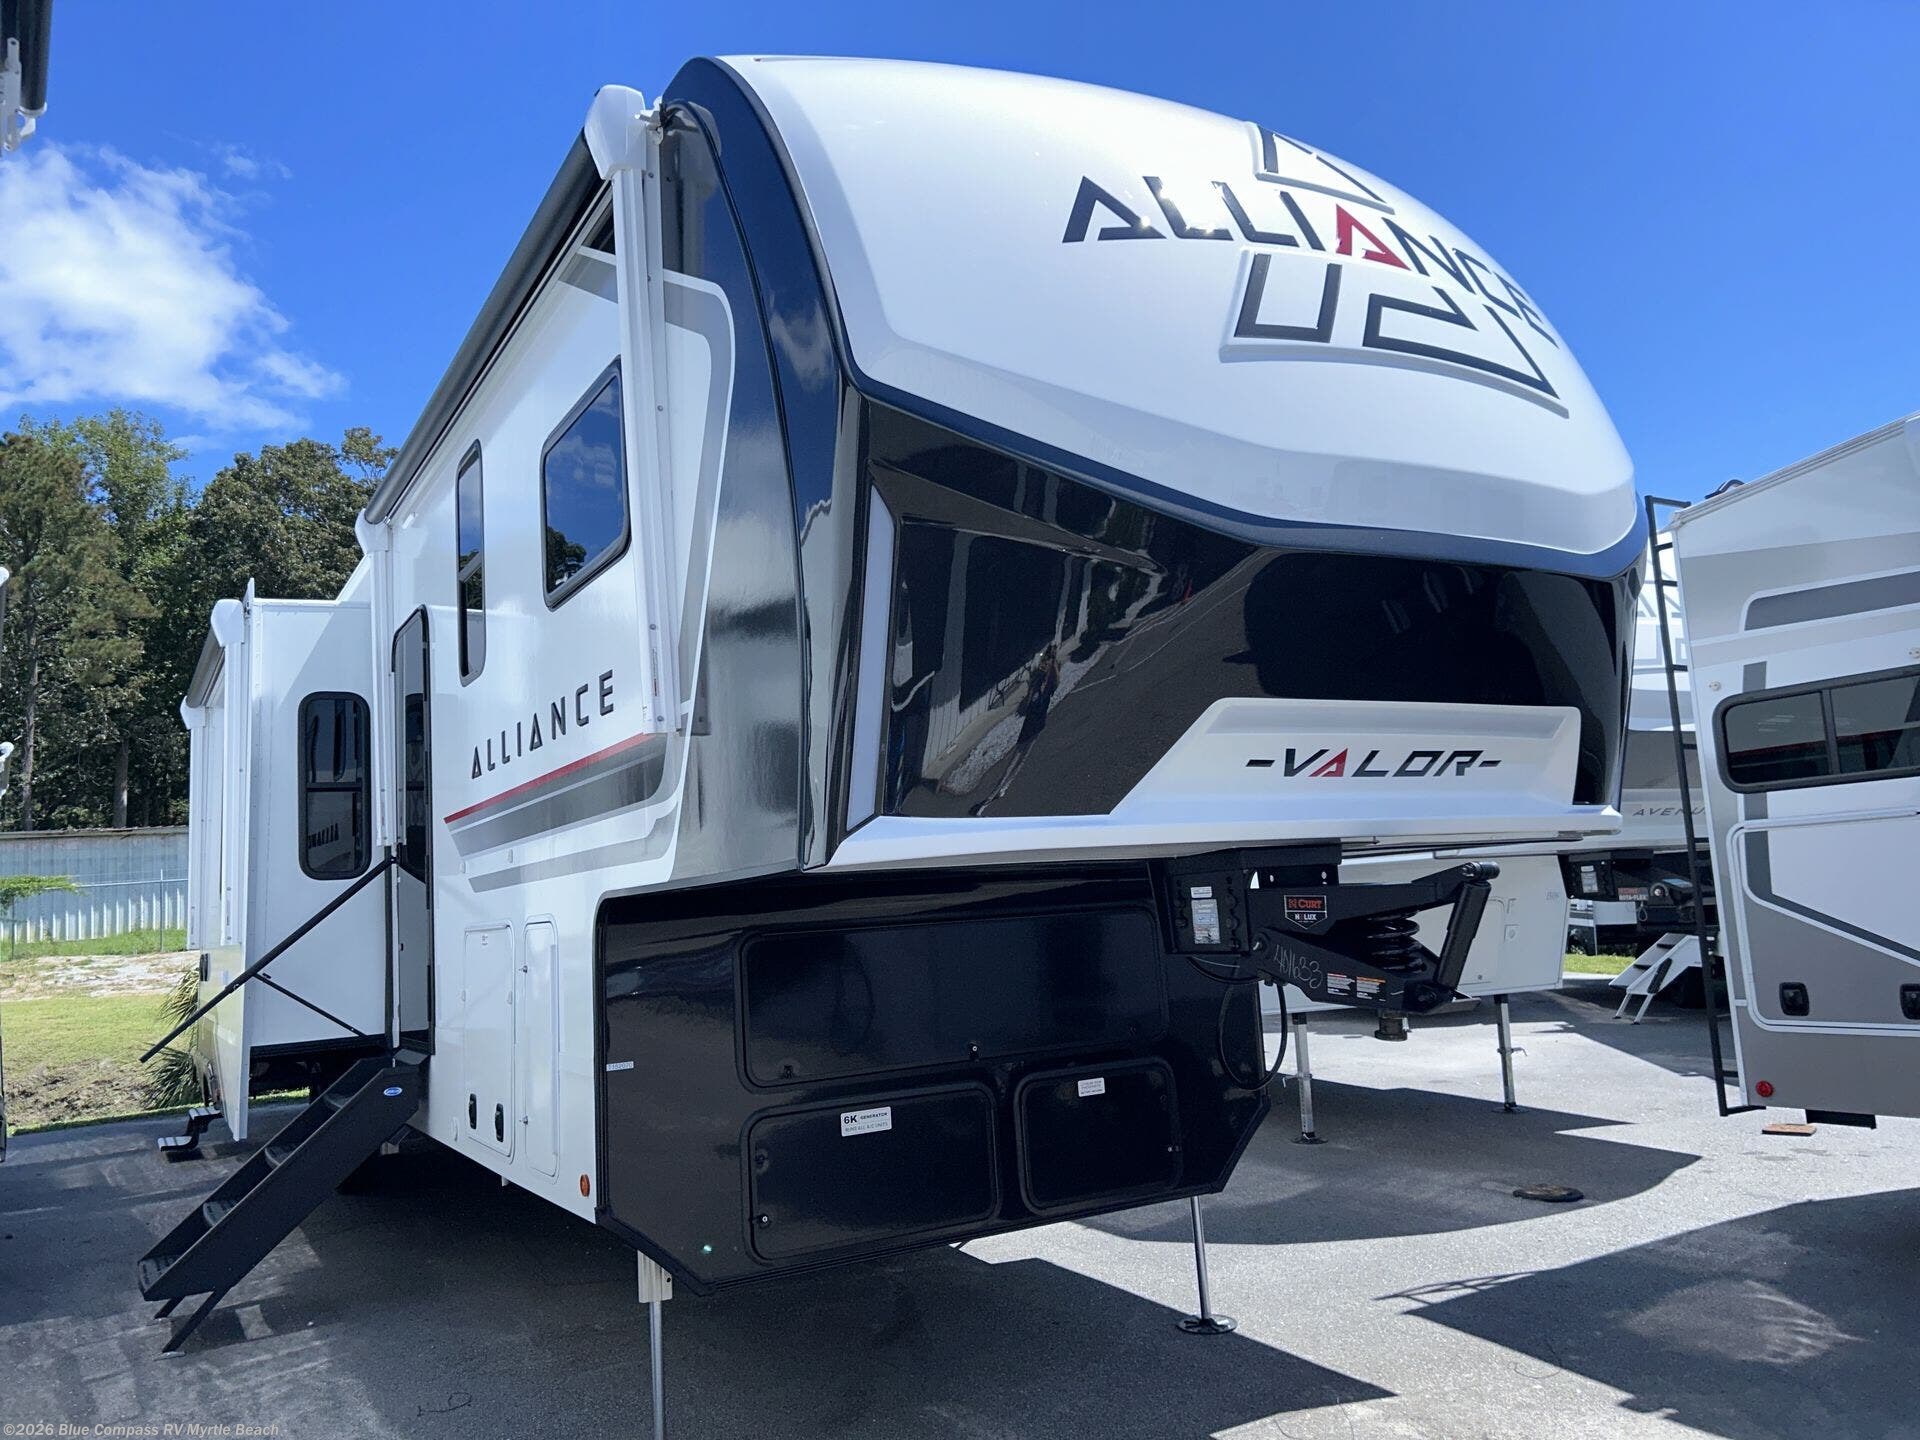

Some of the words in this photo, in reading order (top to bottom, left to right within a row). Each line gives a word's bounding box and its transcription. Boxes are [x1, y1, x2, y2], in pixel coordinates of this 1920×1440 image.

[1062, 175, 1560, 349] ALLIANCE
[471, 669, 614, 780] ALLIANCE
[843, 1115, 858, 1124] 6K
[860, 1112, 888, 1120] GENERATOR
